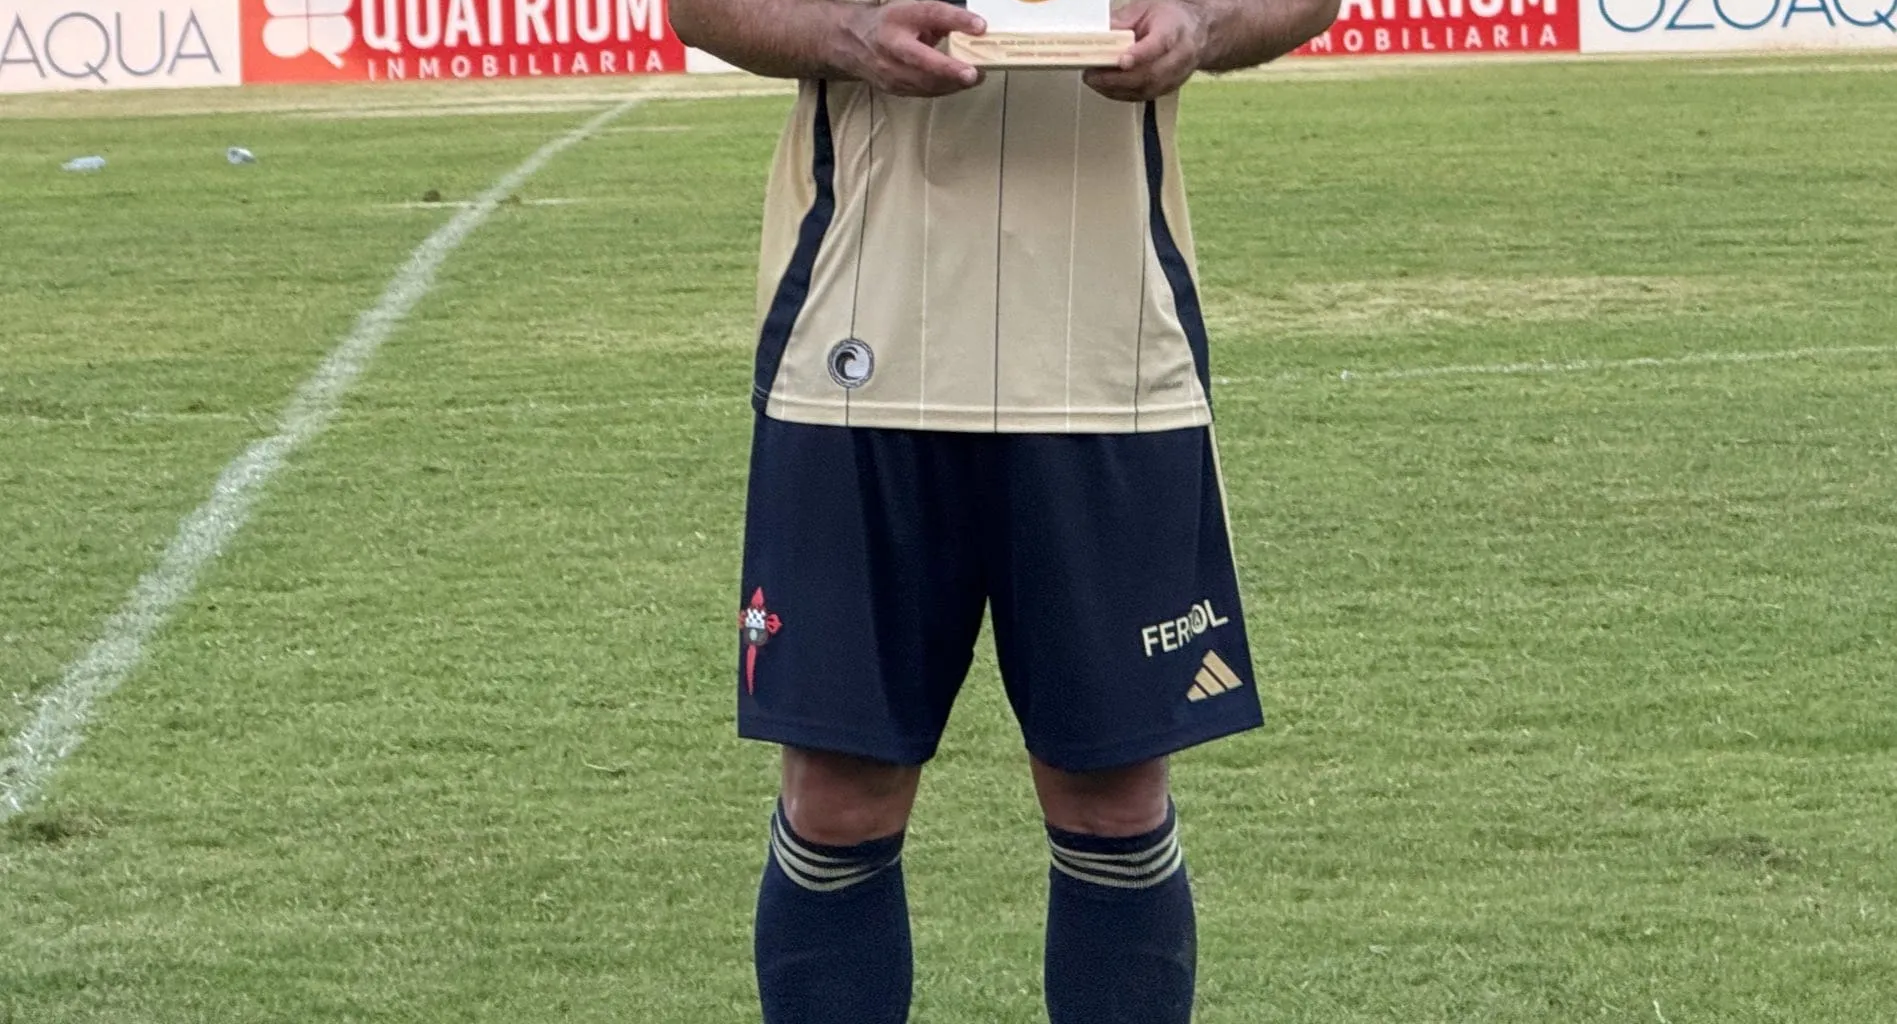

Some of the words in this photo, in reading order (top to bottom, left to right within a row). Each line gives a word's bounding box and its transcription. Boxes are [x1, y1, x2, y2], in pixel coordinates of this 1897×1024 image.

[0, 9, 221, 84] AQUA
[1310, 24, 1558, 53] MOBILIARIA
[368, 49, 664, 81] INMOBILIARIA
